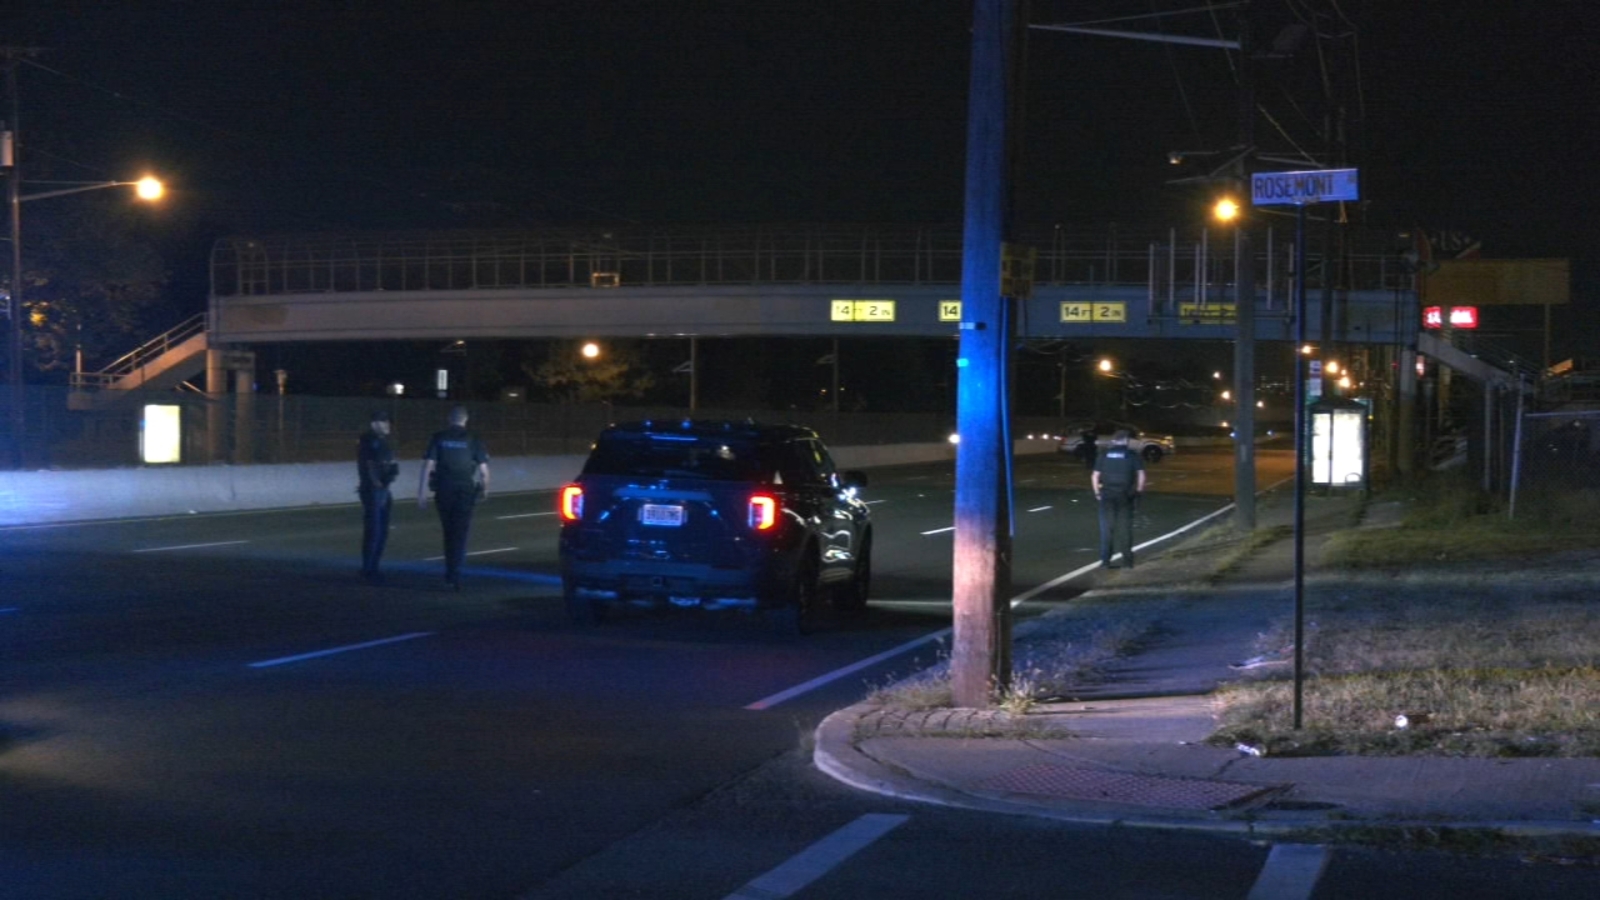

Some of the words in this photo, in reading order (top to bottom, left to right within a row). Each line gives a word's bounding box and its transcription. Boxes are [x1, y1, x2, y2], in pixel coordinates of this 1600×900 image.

[1254, 174, 1334, 199] ROSEMONT
[869, 305, 878, 316] 2
[943, 305, 958, 316] 14
[1064, 305, 1079, 317] 14
[1100, 305, 1110, 317] 2
